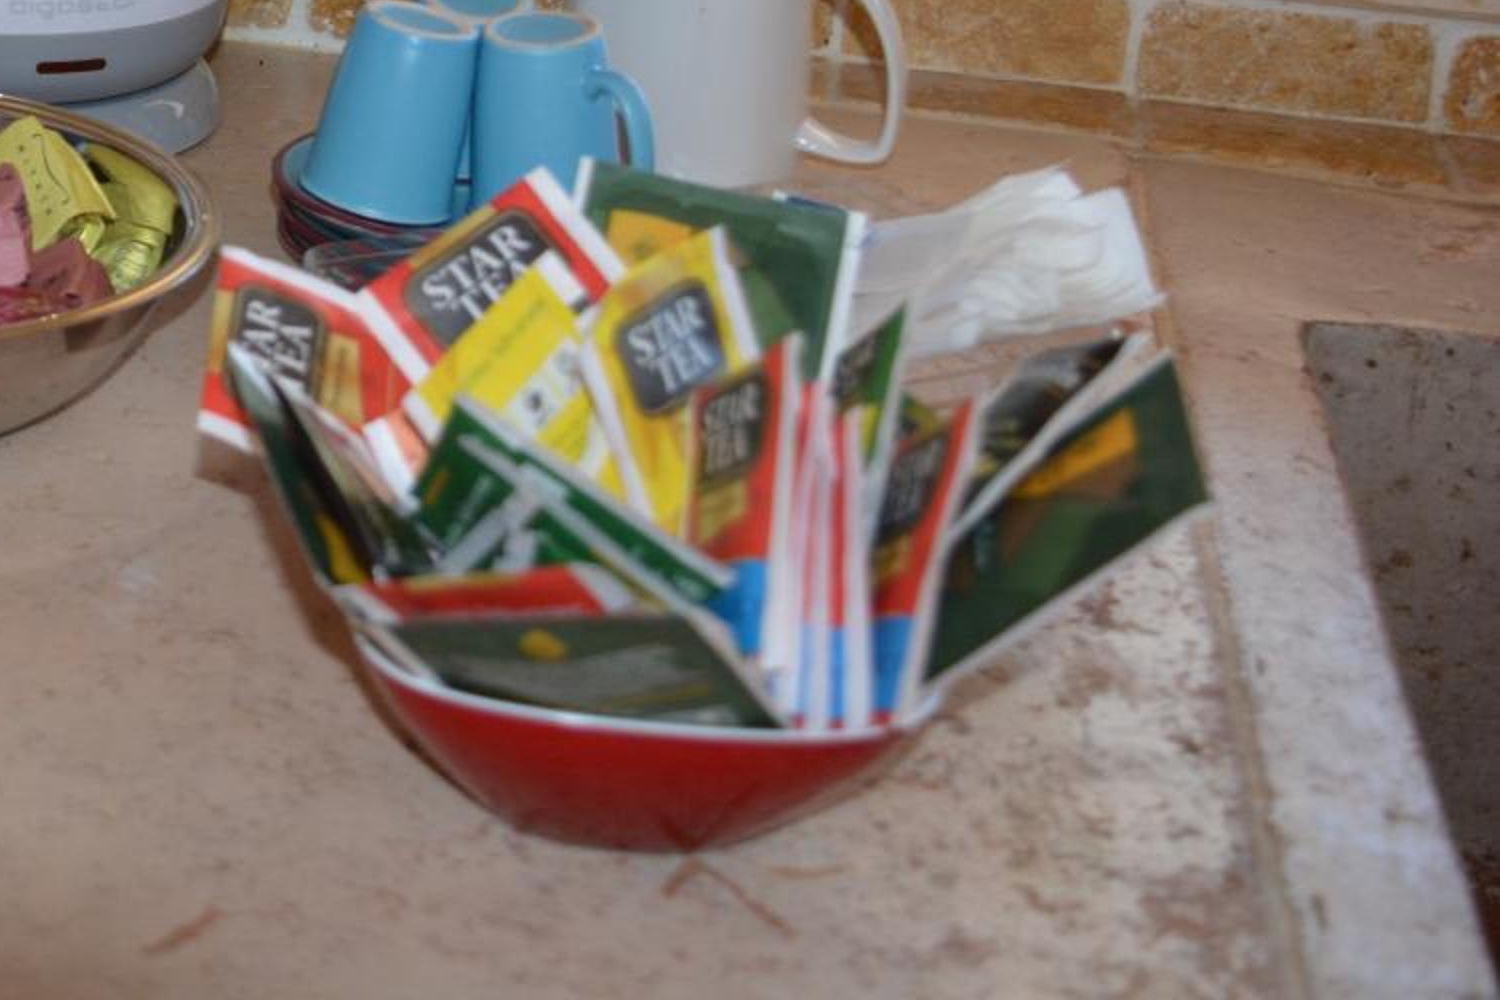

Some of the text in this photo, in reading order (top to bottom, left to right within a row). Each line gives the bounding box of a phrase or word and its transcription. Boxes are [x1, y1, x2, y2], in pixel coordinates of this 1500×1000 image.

[421, 225, 533, 311] STAR
[626, 296, 706, 371] STAR
[651, 336, 721, 395] TEA
